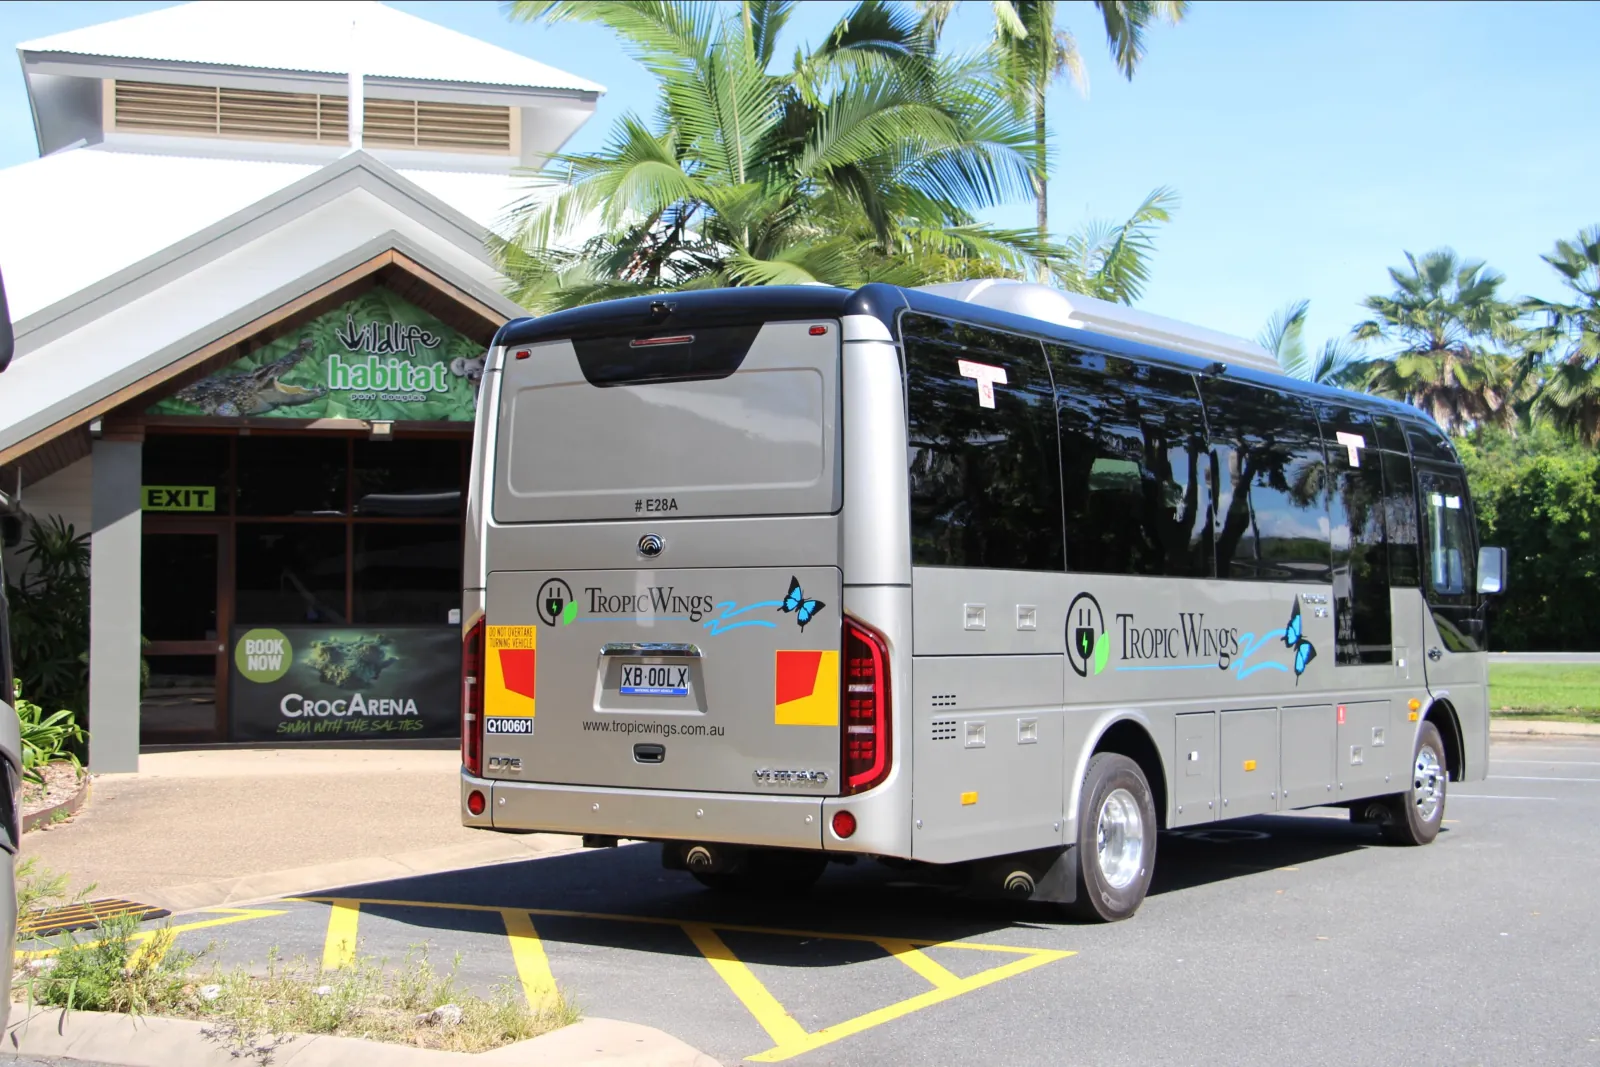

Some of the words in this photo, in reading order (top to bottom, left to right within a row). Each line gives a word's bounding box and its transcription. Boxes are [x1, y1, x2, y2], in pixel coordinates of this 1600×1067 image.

[328, 354, 448, 392] habitat
[381, 393, 427, 403] douglas
[147, 489, 210, 508] EXIT
[646, 498, 678, 512] E28A
[489, 626, 496, 638] DO
[497, 626, 506, 638] NOT
[507, 626, 533, 638] OVERTAKE
[245, 639, 285, 655] BOOK
[489, 637, 510, 648] TURNING
[512, 637, 533, 648] VEHICLE
[247, 655, 283, 671] NOW
[277, 720, 311, 733] SWIM
[313, 719, 342, 733] WITH
[343, 719, 369, 733] THE
[487, 719, 532, 733] Q100601
[582, 720, 725, 738] www.tropicwings.com.au
